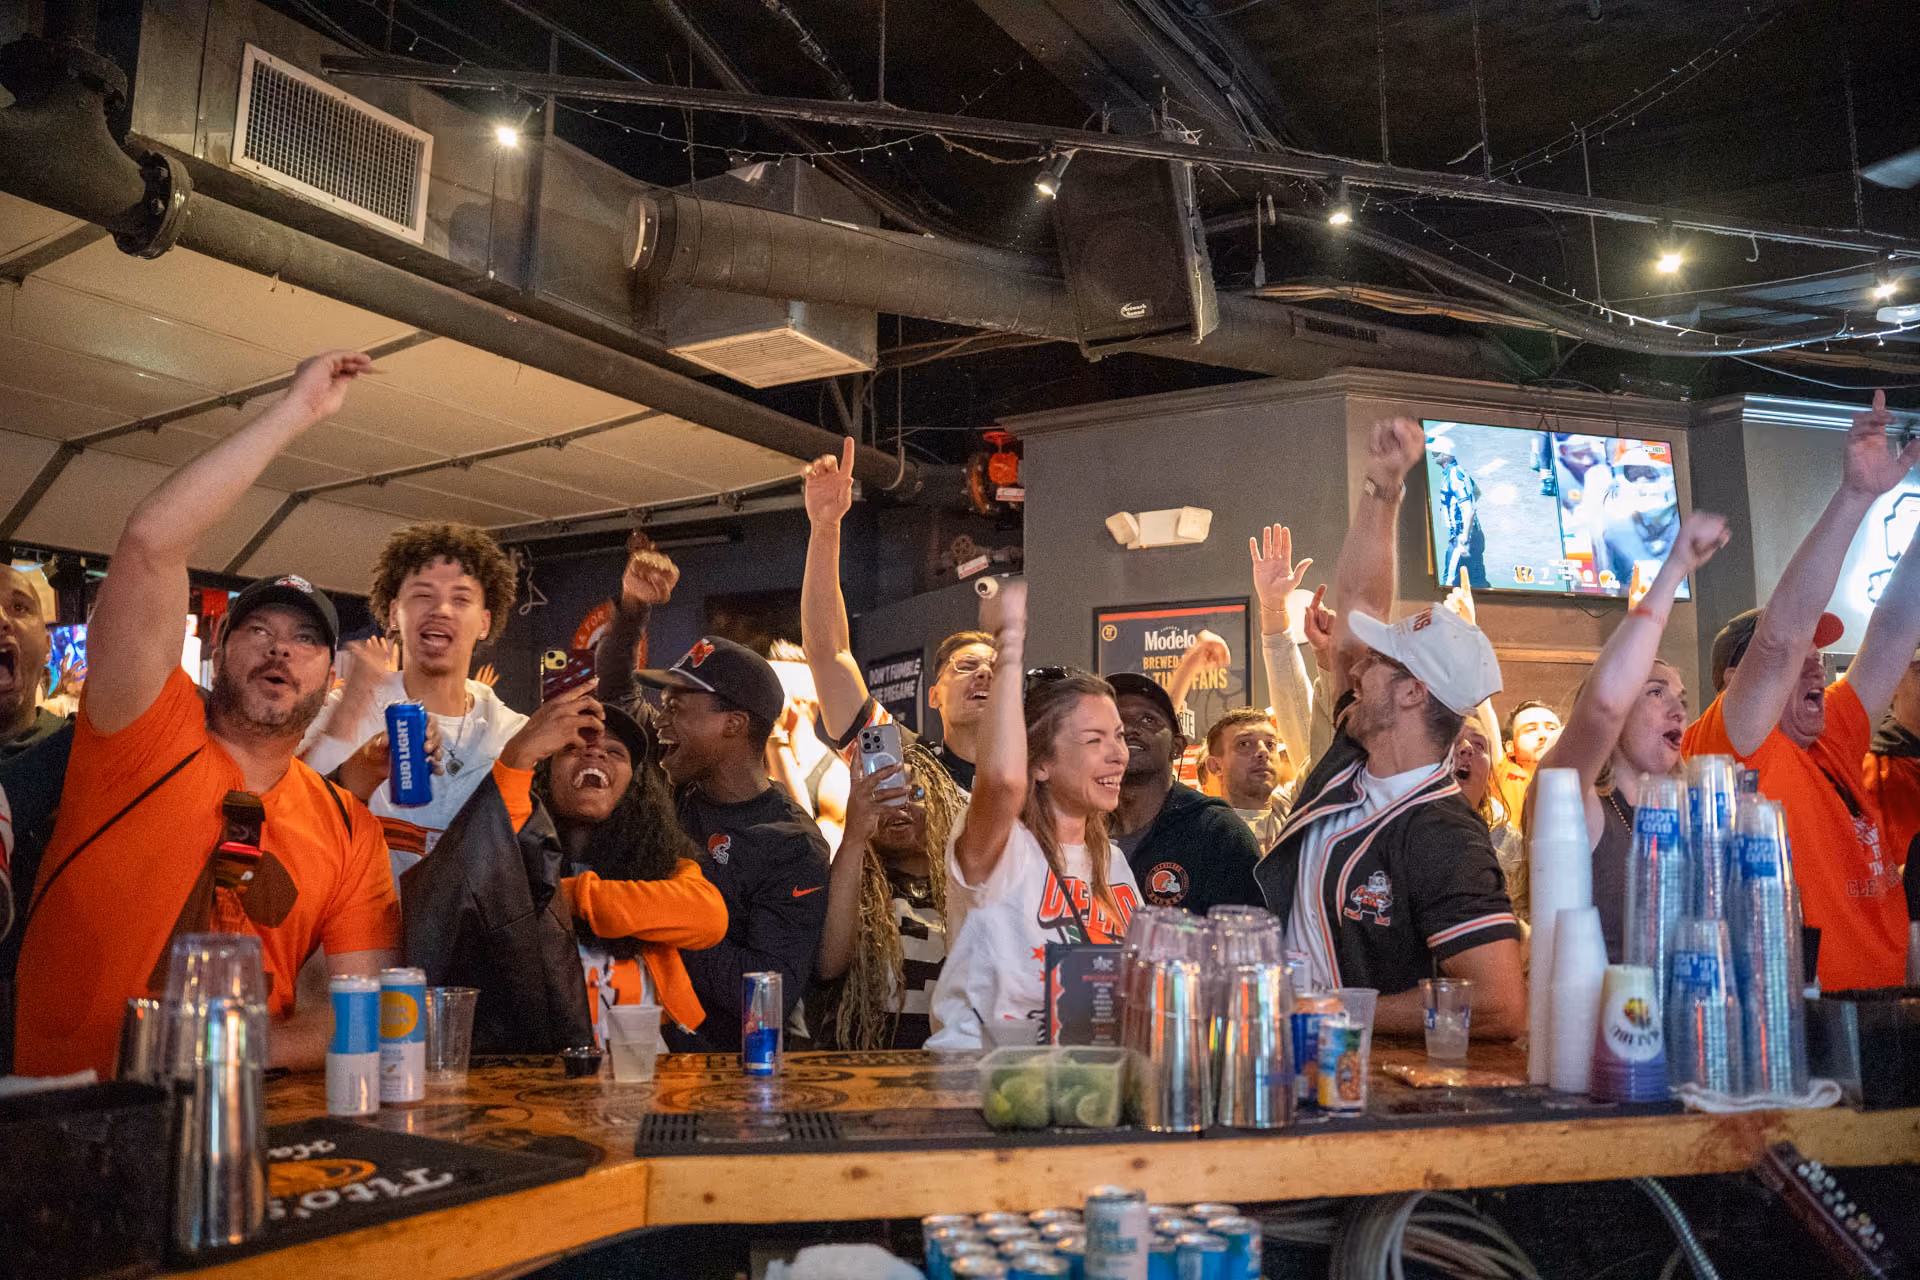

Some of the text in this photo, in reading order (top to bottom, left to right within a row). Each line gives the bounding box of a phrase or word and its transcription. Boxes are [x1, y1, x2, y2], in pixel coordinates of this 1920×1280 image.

[1144, 629, 1197, 651] Modelo
[1142, 655, 1179, 670] BREWED
[1191, 668, 1229, 690] FANS
[396, 719, 412, 790] BUD LIGHT
[1639, 810, 1678, 822] LIGHT
[1642, 821, 1673, 833] BUD
